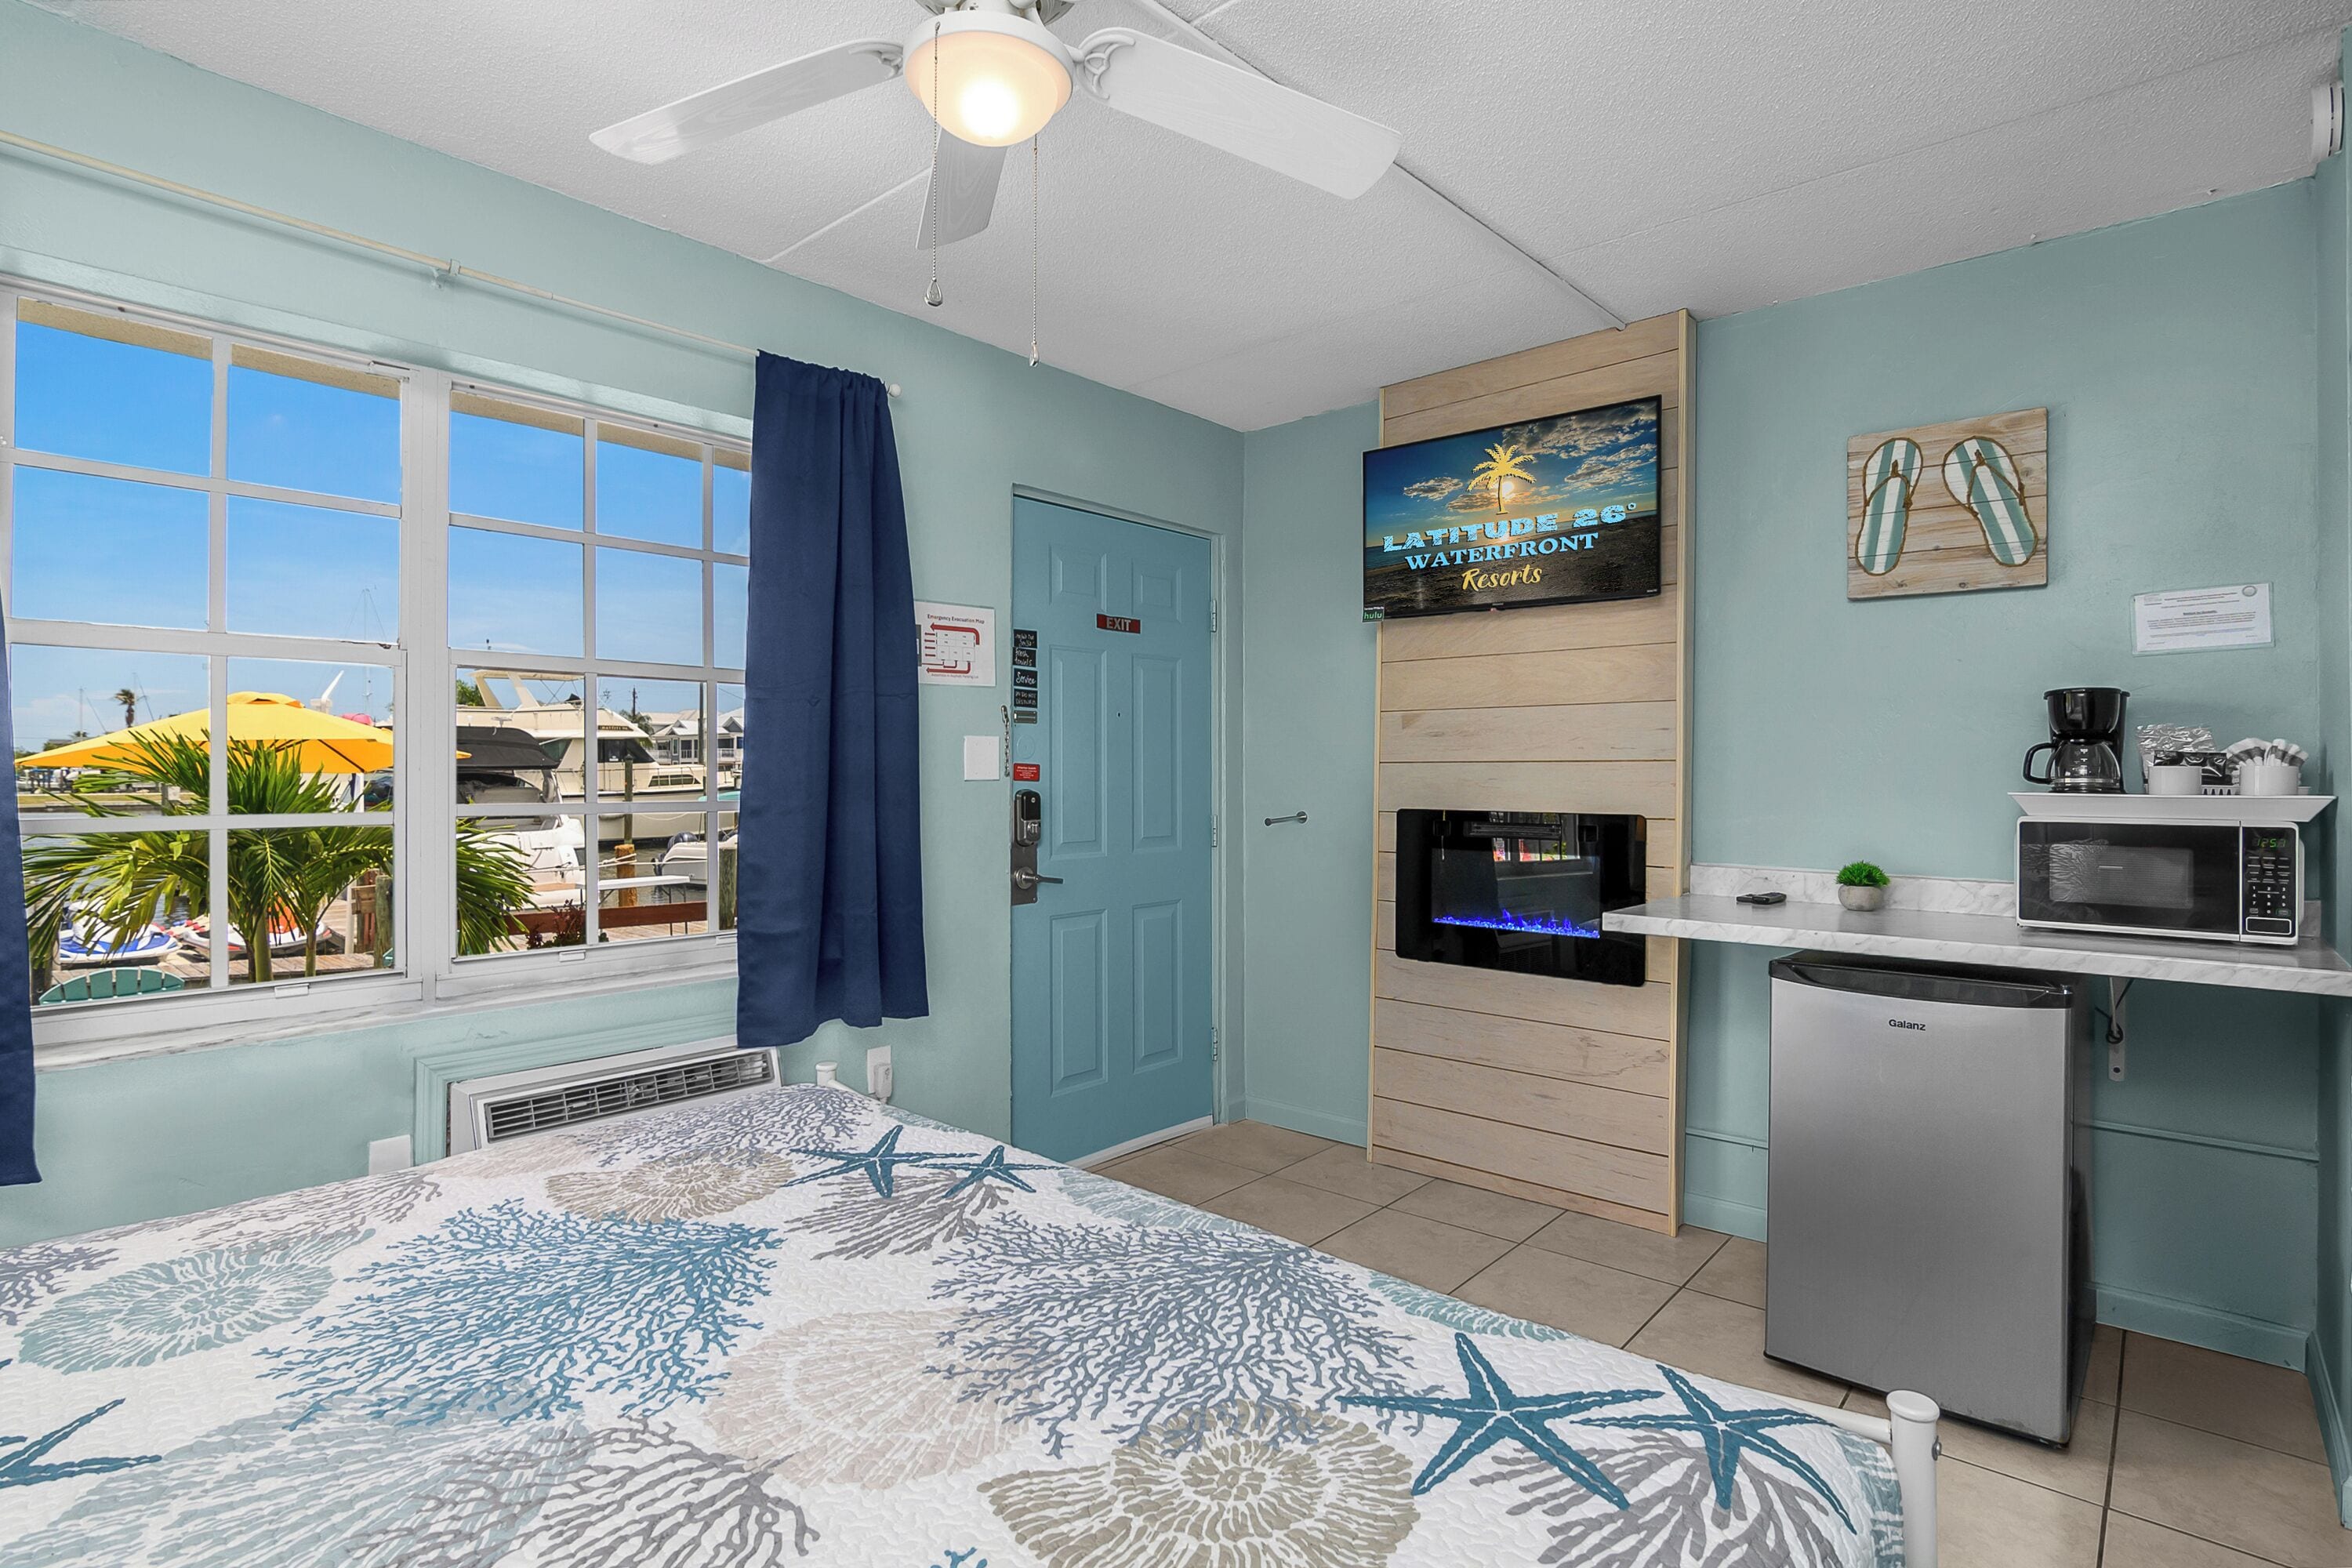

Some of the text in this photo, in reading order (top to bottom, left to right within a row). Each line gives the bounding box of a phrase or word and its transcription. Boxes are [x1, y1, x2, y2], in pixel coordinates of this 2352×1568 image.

[1383, 513, 1559, 553] LATITUDE
[1404, 532, 1599, 570] WATERFRONT
[1461, 564, 1543, 592] Resorts
[927, 613, 951, 622] Emergency
[1363, 611, 1382, 619] hulu
[1106, 616, 1131, 631] EXIT
[1016, 671, 1036, 684] Service
[1888, 1018, 1926, 1032] Galanz
